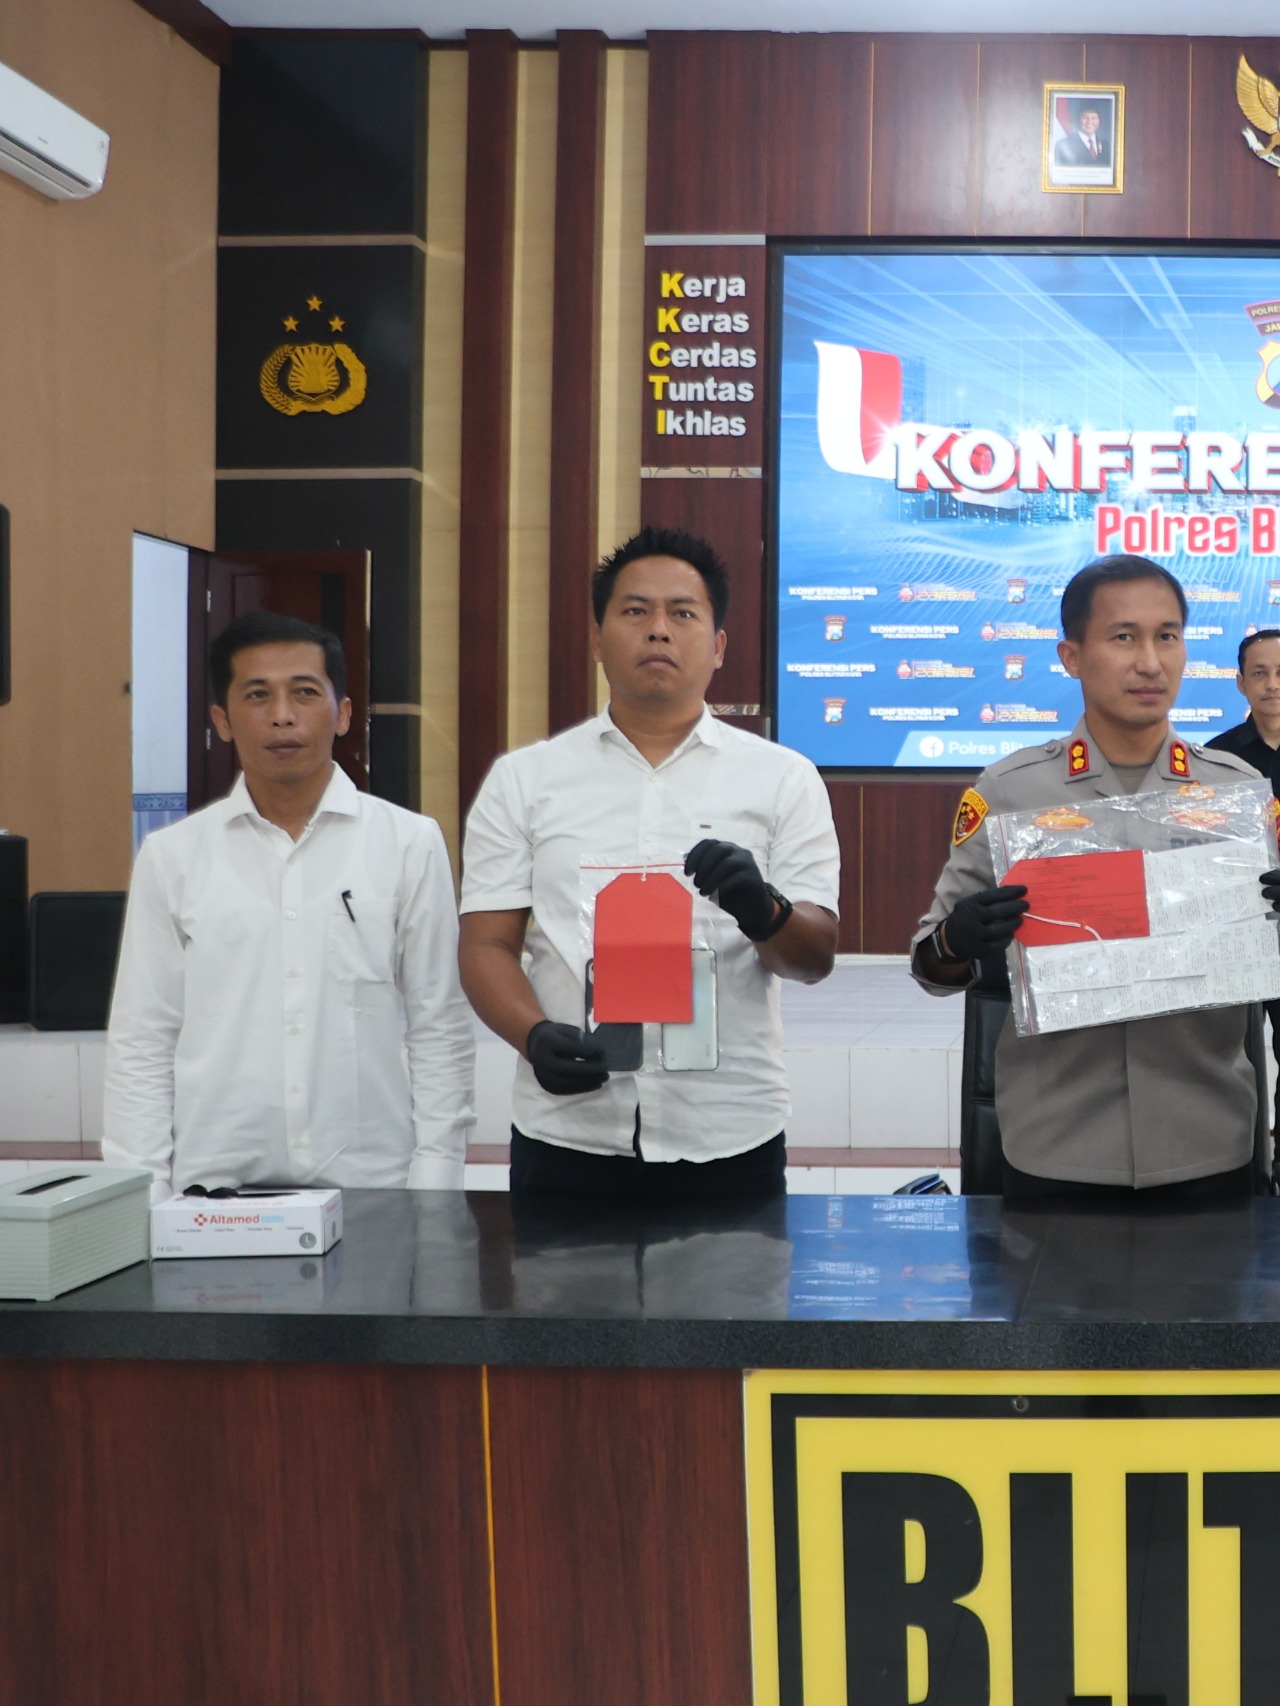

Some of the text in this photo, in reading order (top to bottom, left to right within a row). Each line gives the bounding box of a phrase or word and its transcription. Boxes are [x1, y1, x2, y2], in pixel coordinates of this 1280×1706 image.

[660, 271, 746, 303] Kerja
[657, 306, 750, 333] Keras
[648, 340, 757, 367] Cerdas
[647, 374, 755, 402] Tuntas
[656, 408, 747, 436] Ikhlas
[1097, 506, 1239, 555] Polres
[949, 741, 1024, 755] Polres Blit
[209, 1214, 260, 1225] Altamed
